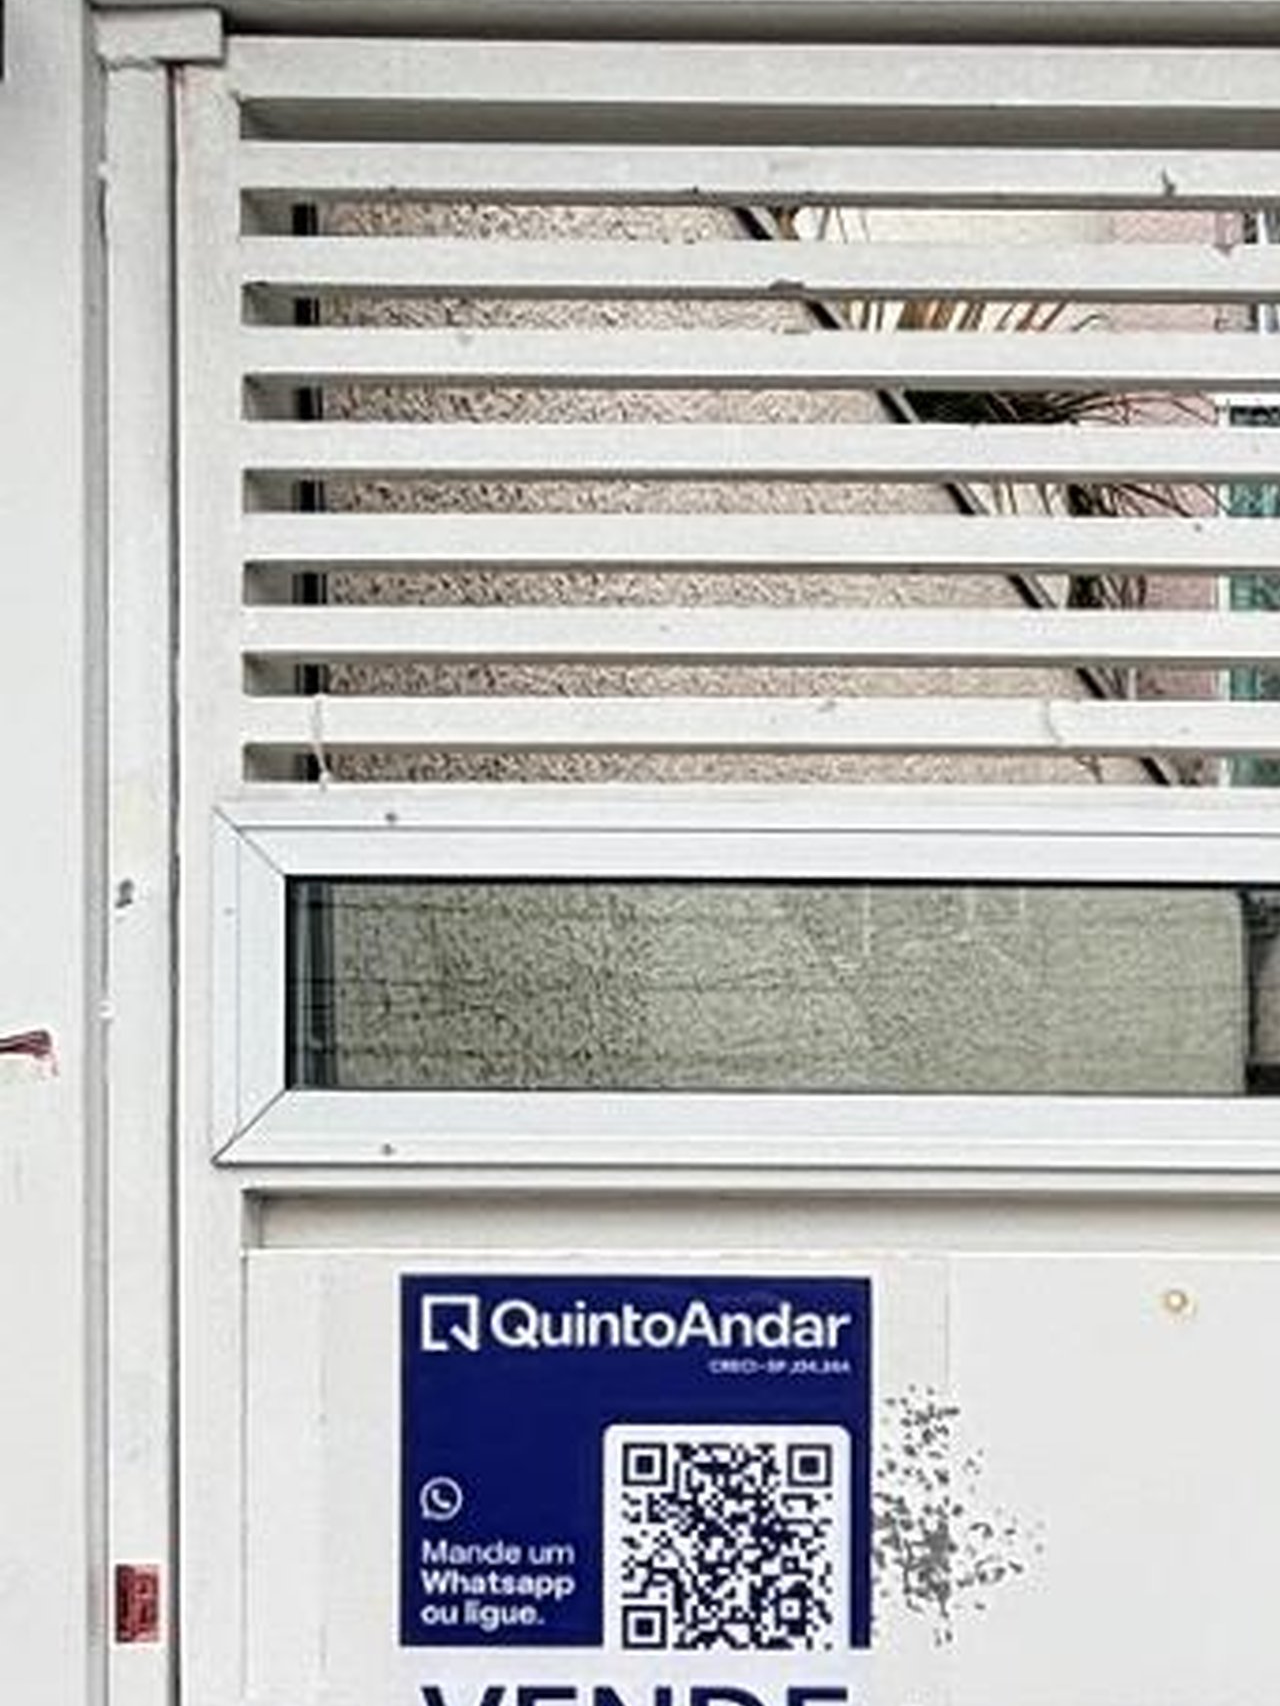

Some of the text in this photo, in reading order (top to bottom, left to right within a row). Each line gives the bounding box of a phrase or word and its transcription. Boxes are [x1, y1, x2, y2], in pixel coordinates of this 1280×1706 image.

[490, 1299, 852, 1349] QuintoAndar
[421, 1538, 575, 1565] Mande um
[421, 1568, 575, 1601] Whatsapp
[420, 1598, 546, 1633] ou ligue.
